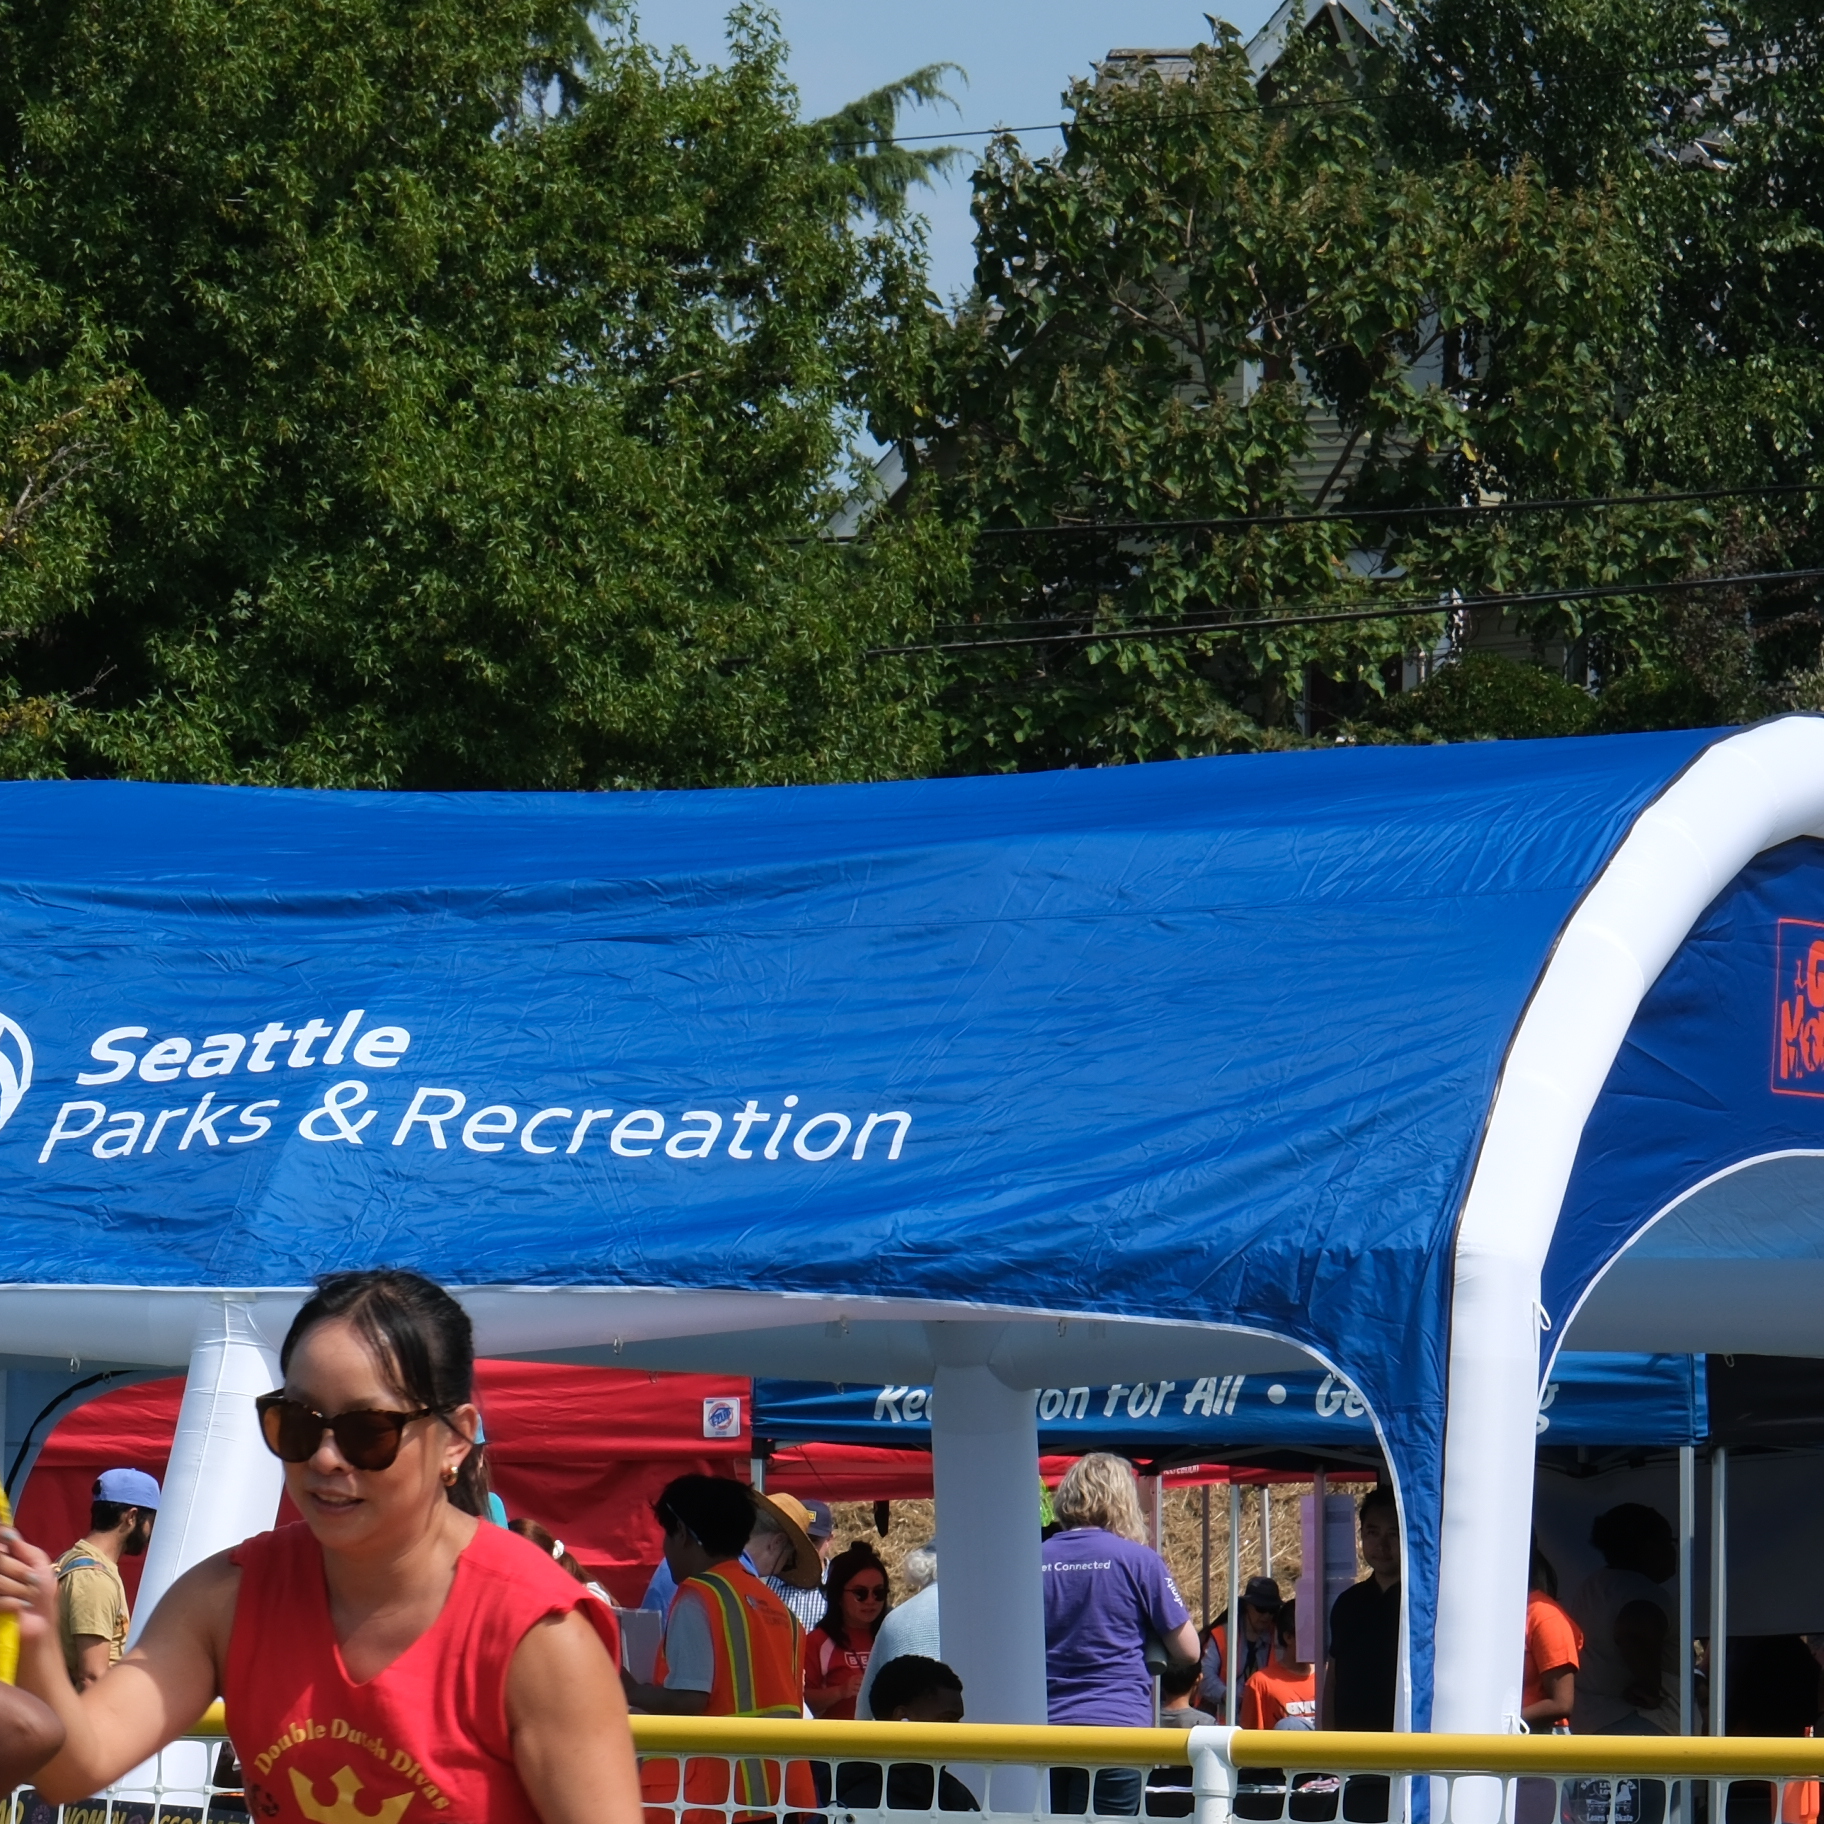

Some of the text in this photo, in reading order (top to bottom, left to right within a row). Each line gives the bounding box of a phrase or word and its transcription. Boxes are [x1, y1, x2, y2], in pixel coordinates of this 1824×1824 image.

[76, 1008, 411, 1087] Seattle
[37, 1079, 914, 1167] Parks & Recreation
[1183, 1374, 1245, 1417] All
[1054, 1559, 1111, 1572] Connected
[254, 1718, 451, 1811] Double Dutch Divas
